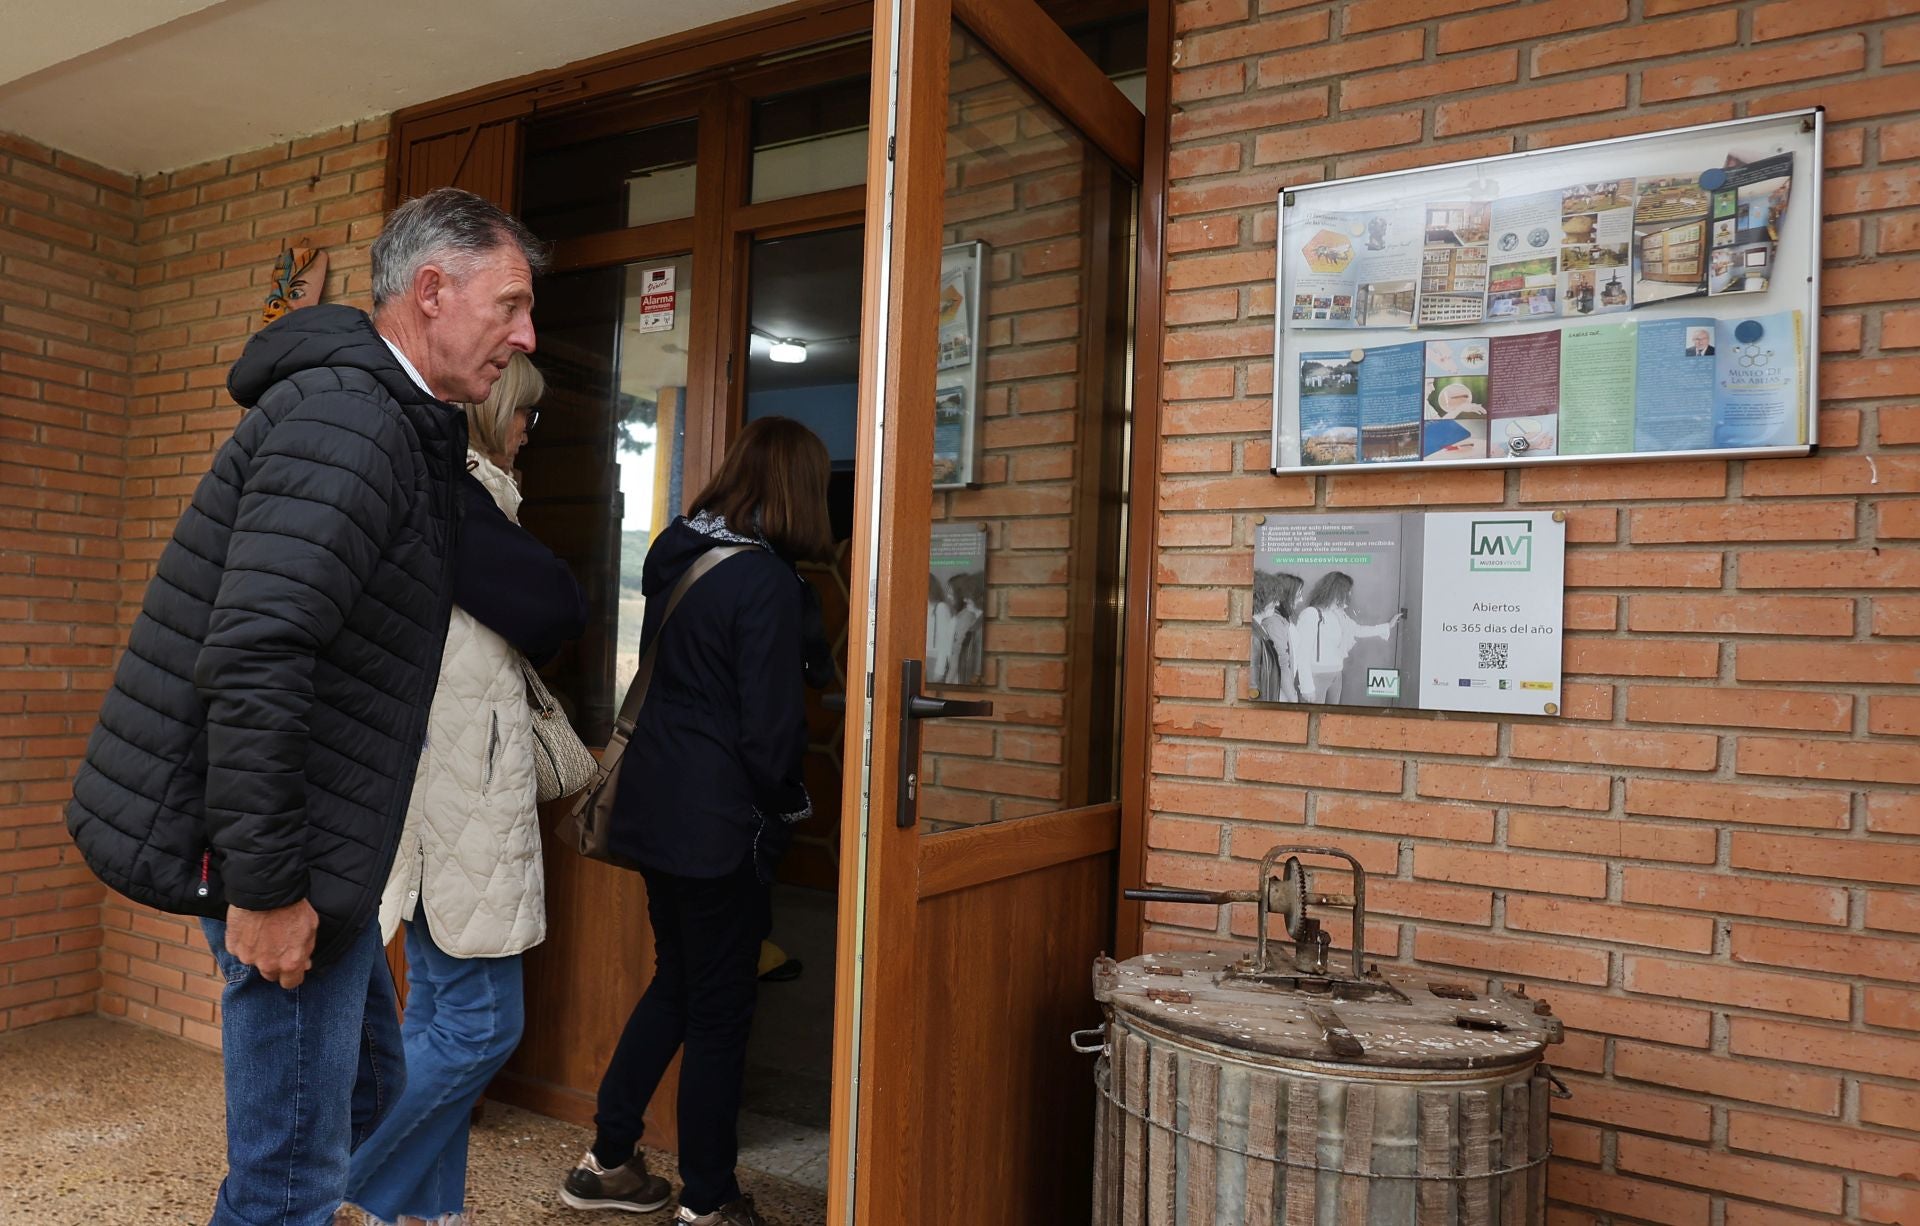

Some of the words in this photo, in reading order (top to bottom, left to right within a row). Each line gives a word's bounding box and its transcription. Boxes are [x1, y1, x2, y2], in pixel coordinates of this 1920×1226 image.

[642, 295, 673, 305] Alarma
[1472, 602, 1521, 612] Abiertos
[1442, 622, 1458, 632] los
[1460, 623, 1481, 633] 365
[1509, 624, 1528, 634] del
[1530, 624, 1553, 634] año
